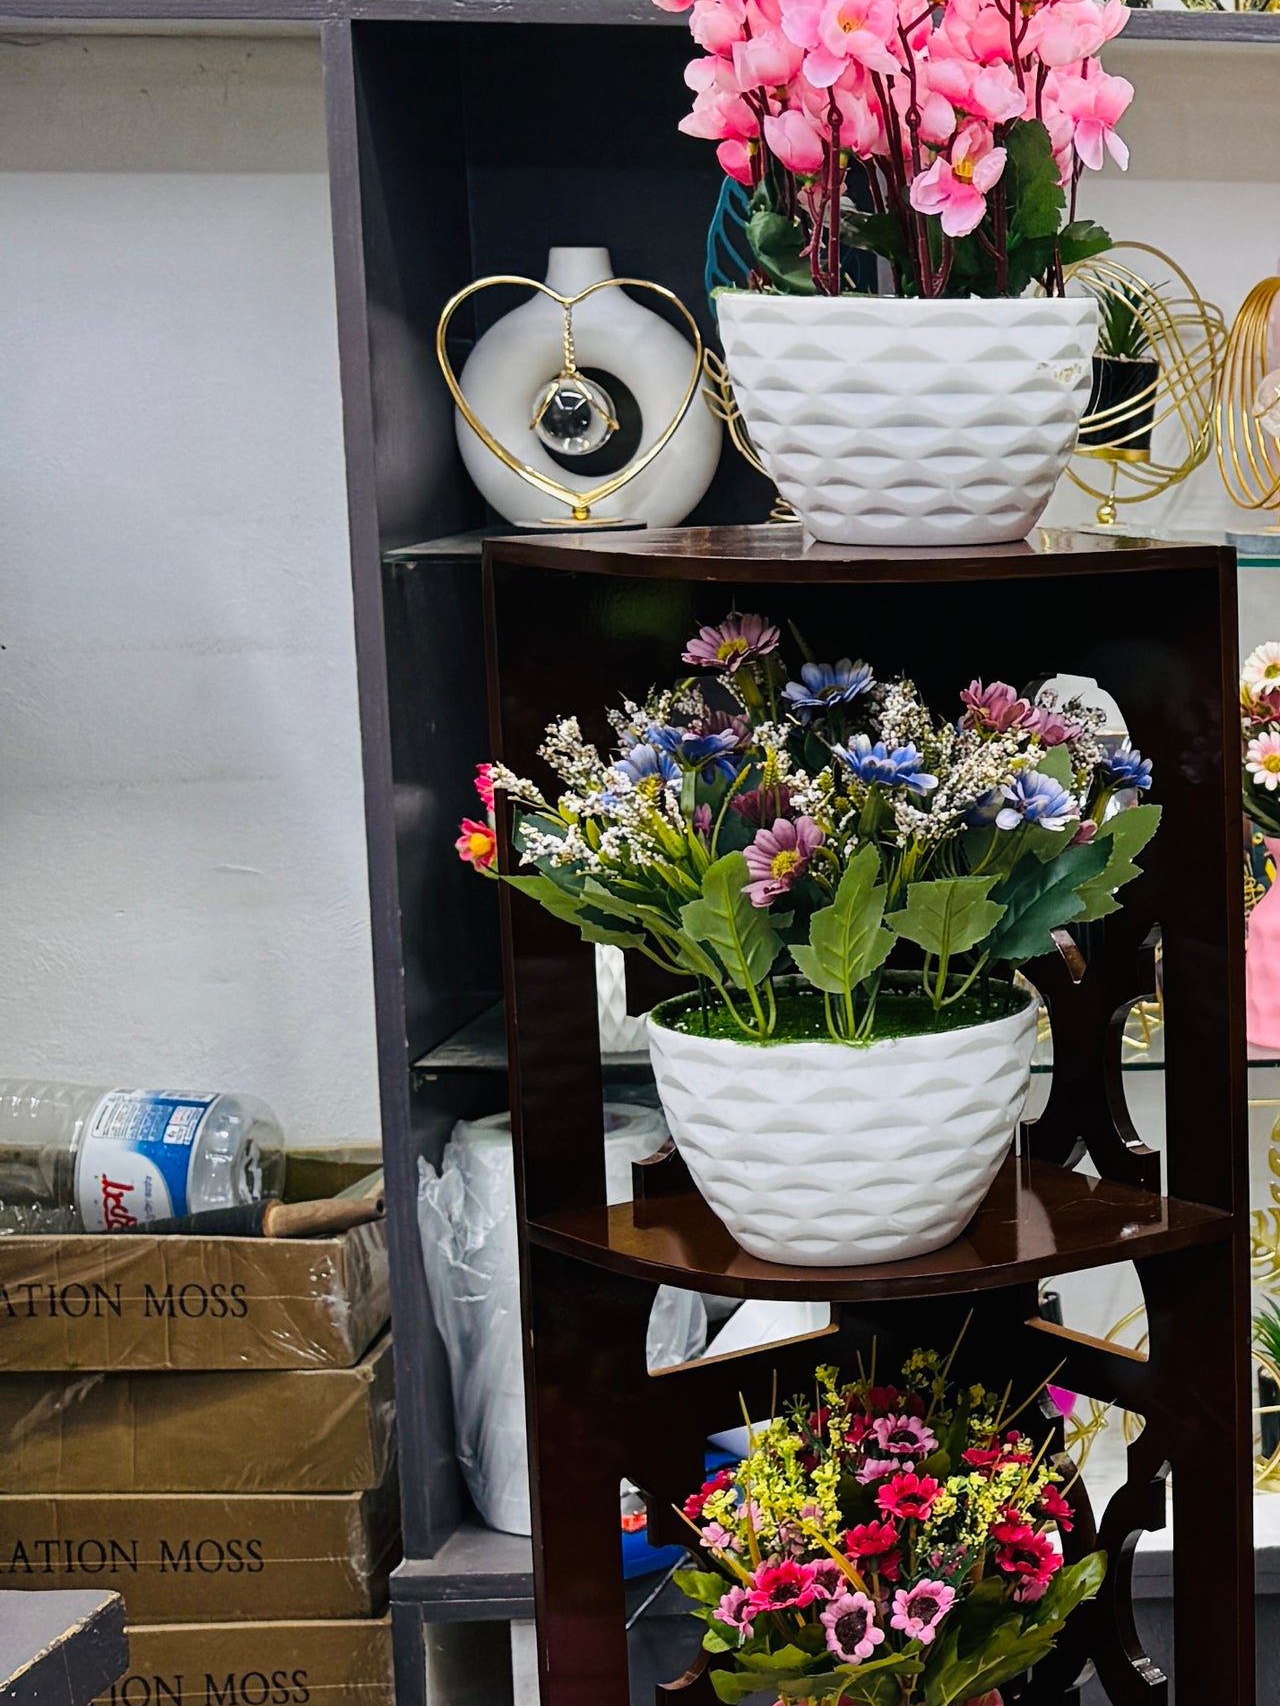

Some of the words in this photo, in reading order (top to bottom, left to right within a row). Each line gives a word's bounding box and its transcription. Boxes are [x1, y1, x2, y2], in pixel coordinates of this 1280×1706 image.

[143, 1282, 249, 1319] MOSS
[0, 1538, 139, 1574] ATION
[159, 1538, 265, 1574] MOSS
